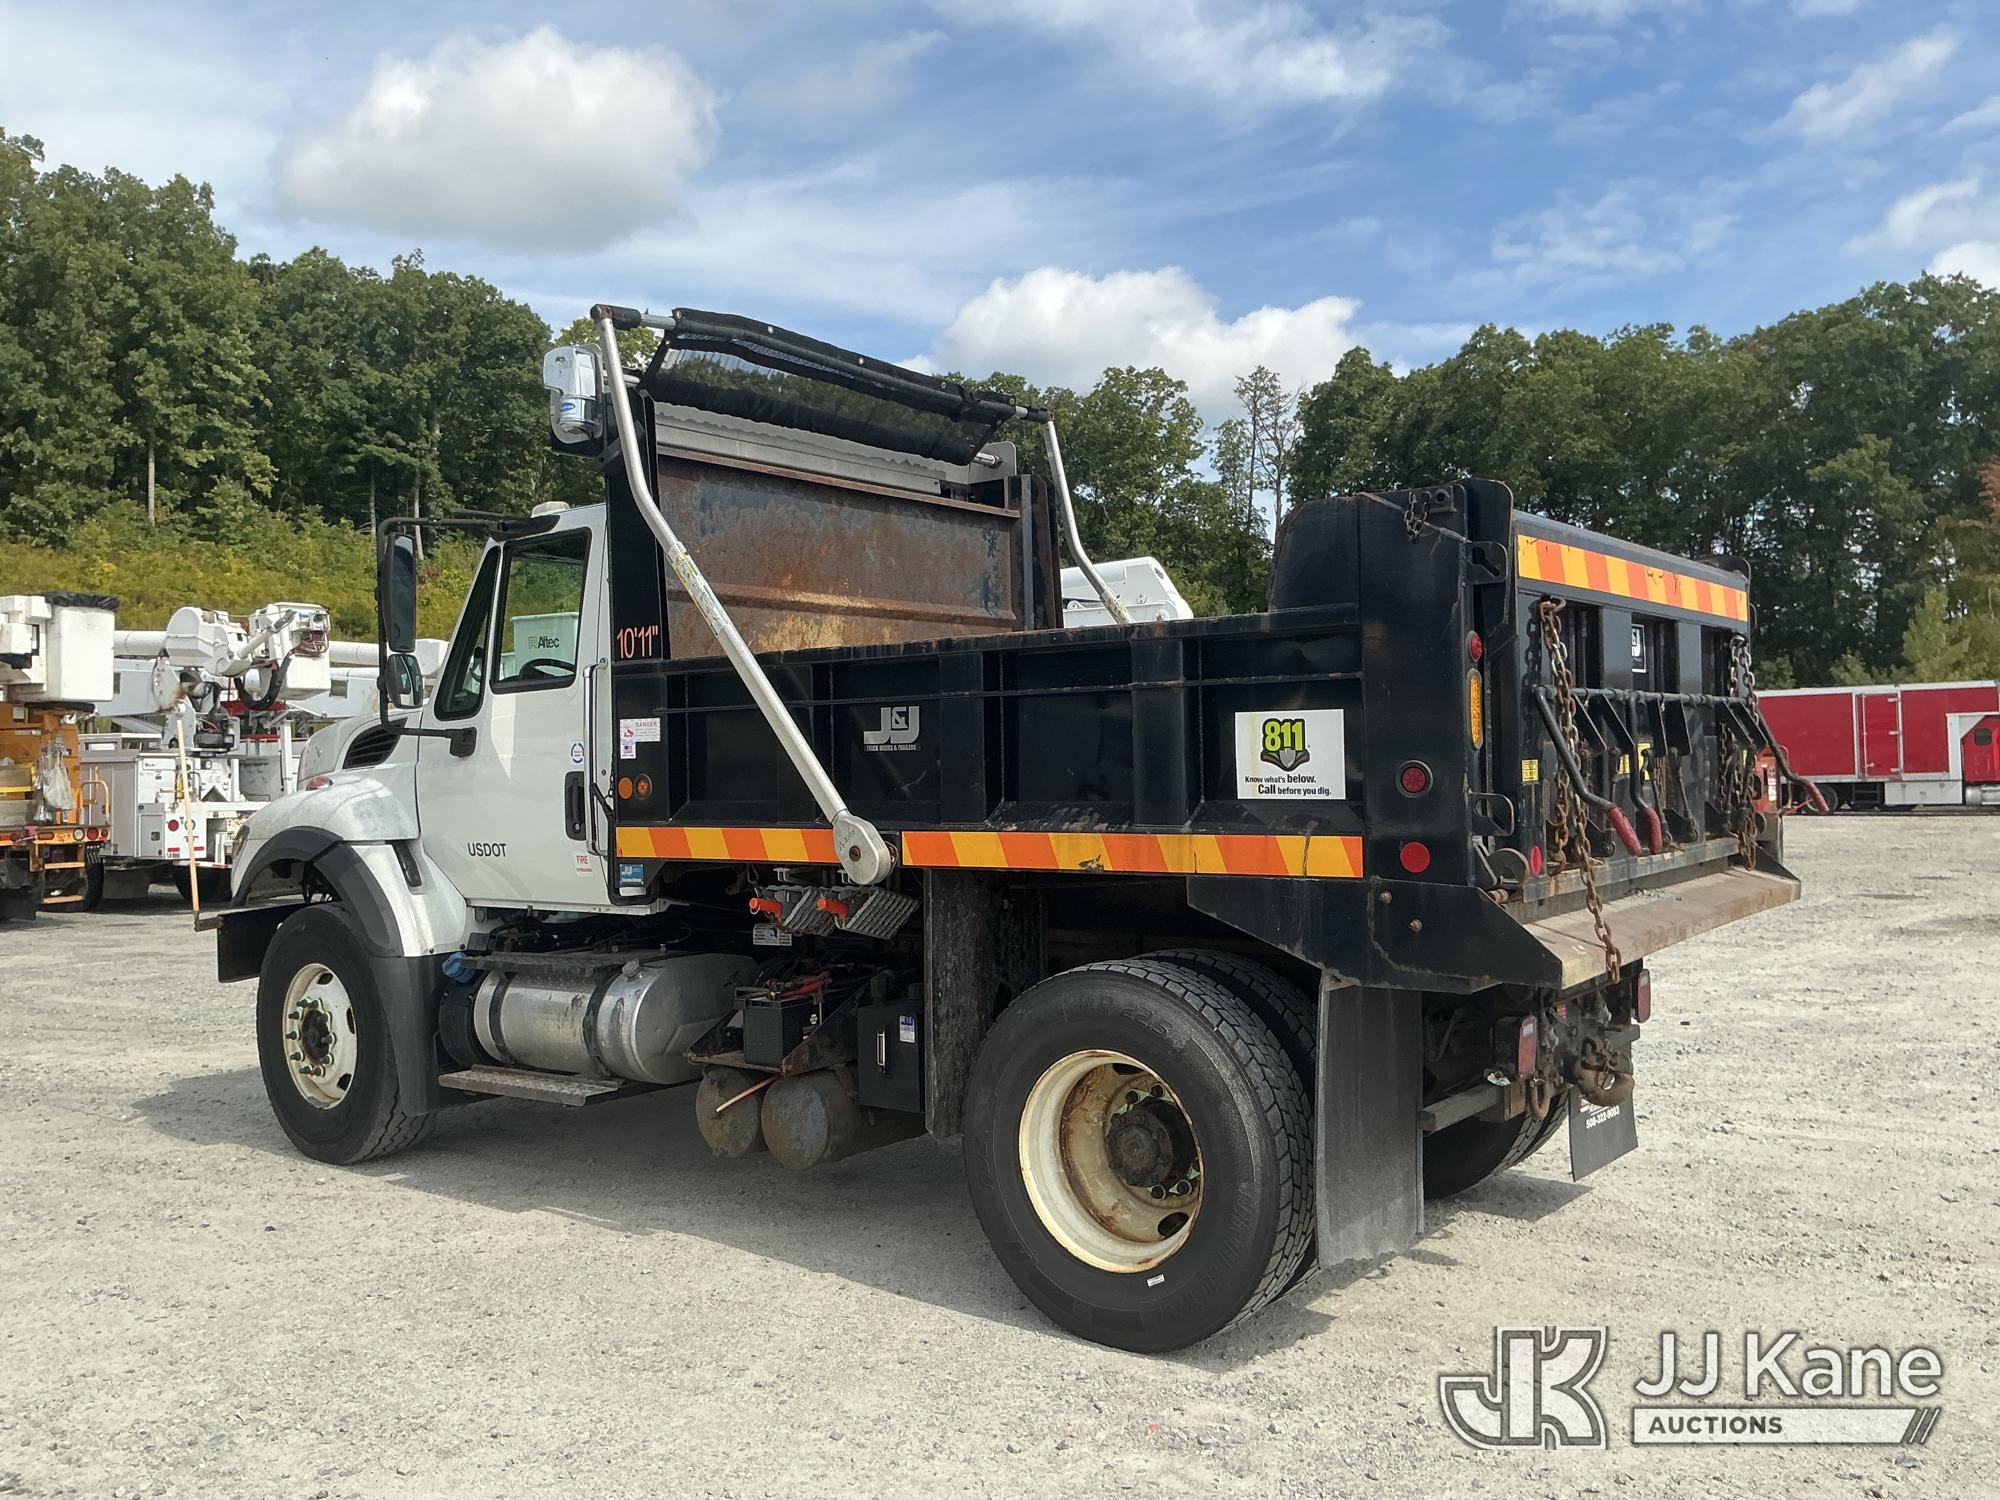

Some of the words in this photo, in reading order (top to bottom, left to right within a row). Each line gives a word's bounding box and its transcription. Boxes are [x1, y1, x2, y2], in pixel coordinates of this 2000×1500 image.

[538, 636, 560, 649] Altec
[616, 625, 659, 659] 10'11"
[863, 706, 920, 744] J&J
[1264, 720, 1304, 752] 811
[1244, 775, 1263, 784] Know
[1264, 775, 1286, 784] what's
[1287, 774, 1317, 784] below.
[1258, 784, 1276, 795] Call
[1277, 786, 1302, 795] before
[1303, 787, 1317, 797] you
[1317, 786, 1332, 797] dig.
[467, 842, 507, 857] USDOT
[576, 855, 589, 865] FIRE
